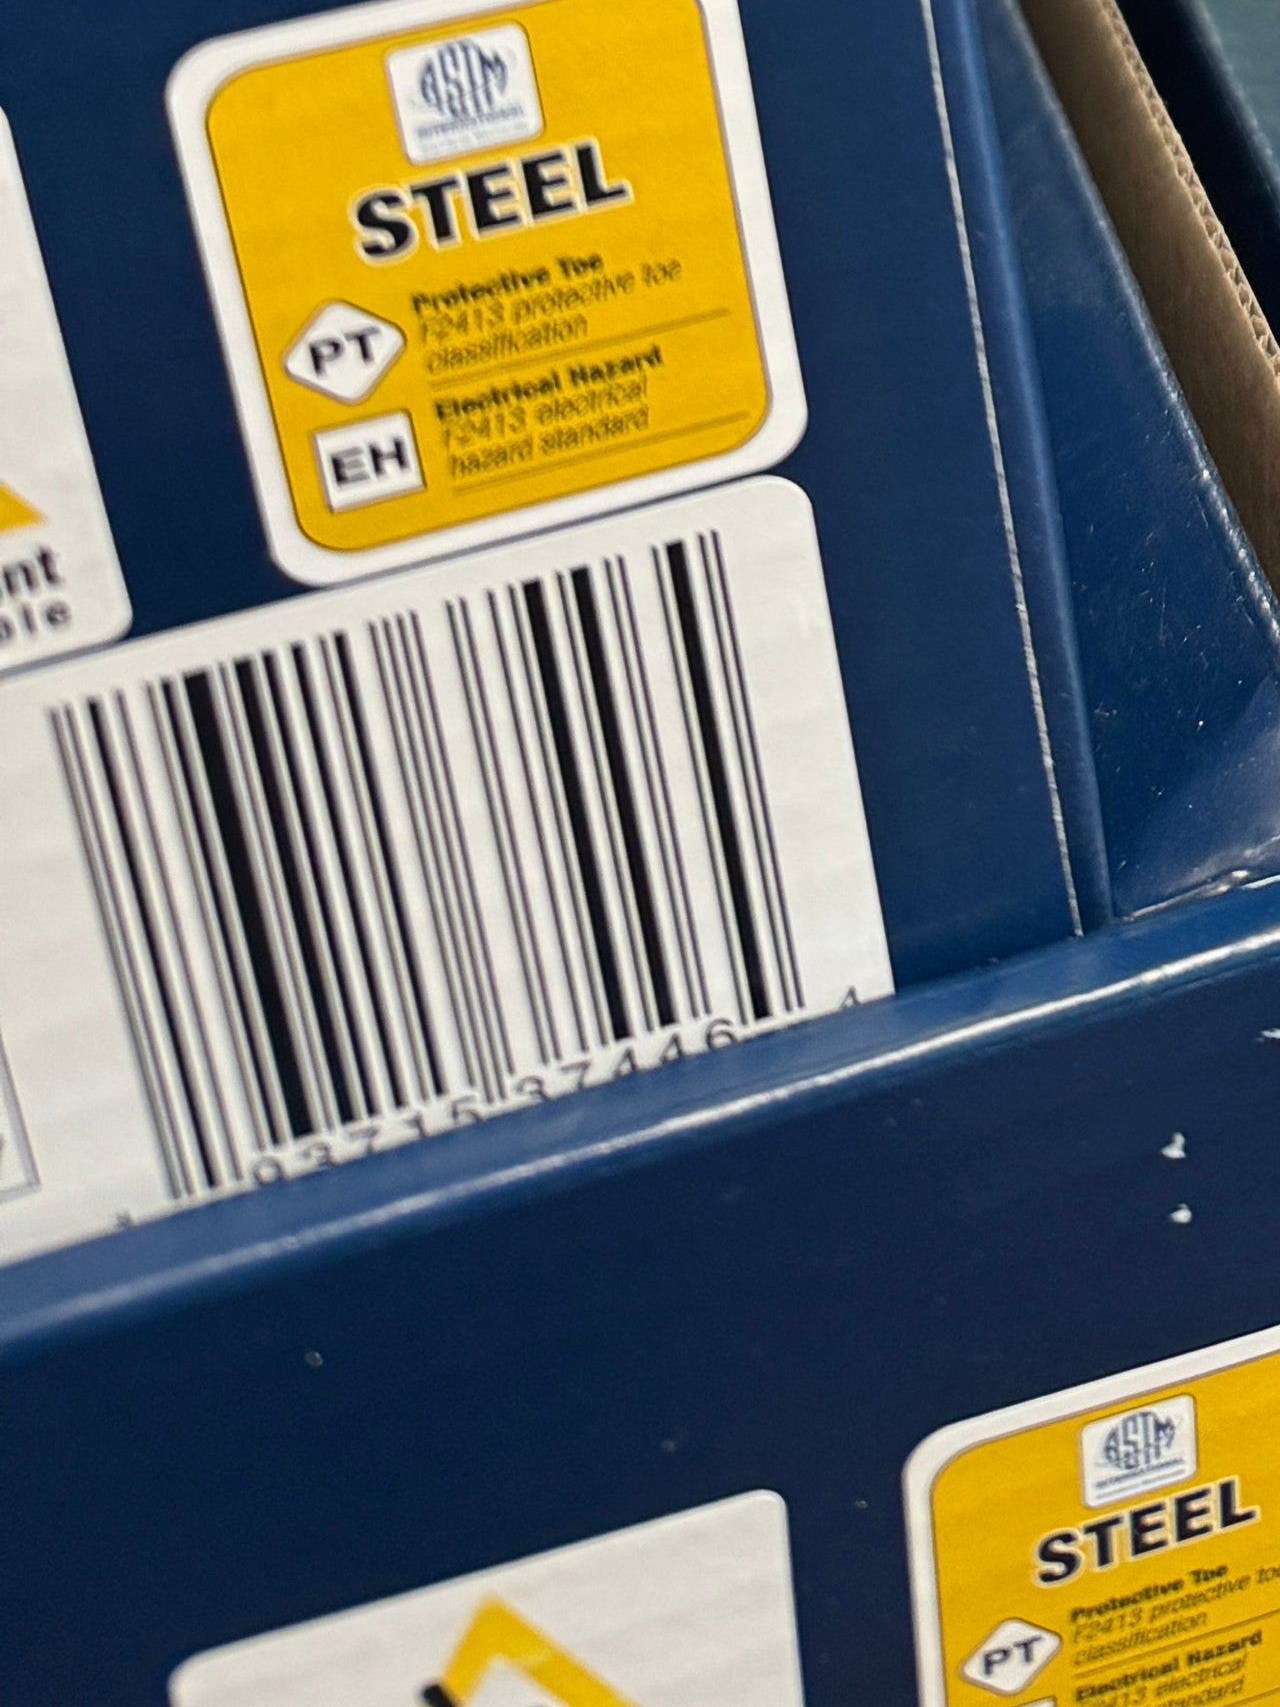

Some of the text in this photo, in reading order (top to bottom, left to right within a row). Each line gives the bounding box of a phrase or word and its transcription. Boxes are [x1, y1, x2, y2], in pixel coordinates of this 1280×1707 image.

[418, 38, 511, 119] ASTM
[349, 136, 633, 265] STEEL
[411, 252, 605, 316] Protective Toe
[510, 271, 637, 327] protective
[640, 258, 683, 289] toe
[307, 325, 382, 379] PT
[426, 313, 590, 375] classification
[434, 343, 664, 423] Electrical Hazard
[329, 434, 412, 490] EH
[450, 402, 651, 483] hazard standard
[1102, 1411, 1176, 1471] ASTM
[1035, 1477, 1260, 1586] STEEL
[1070, 1564, 1229, 1624] Protective Toe
[1149, 1575, 1252, 1623] protective
[981, 1635, 1044, 1677] PT
[1185, 1629, 1263, 1668] Hazard
